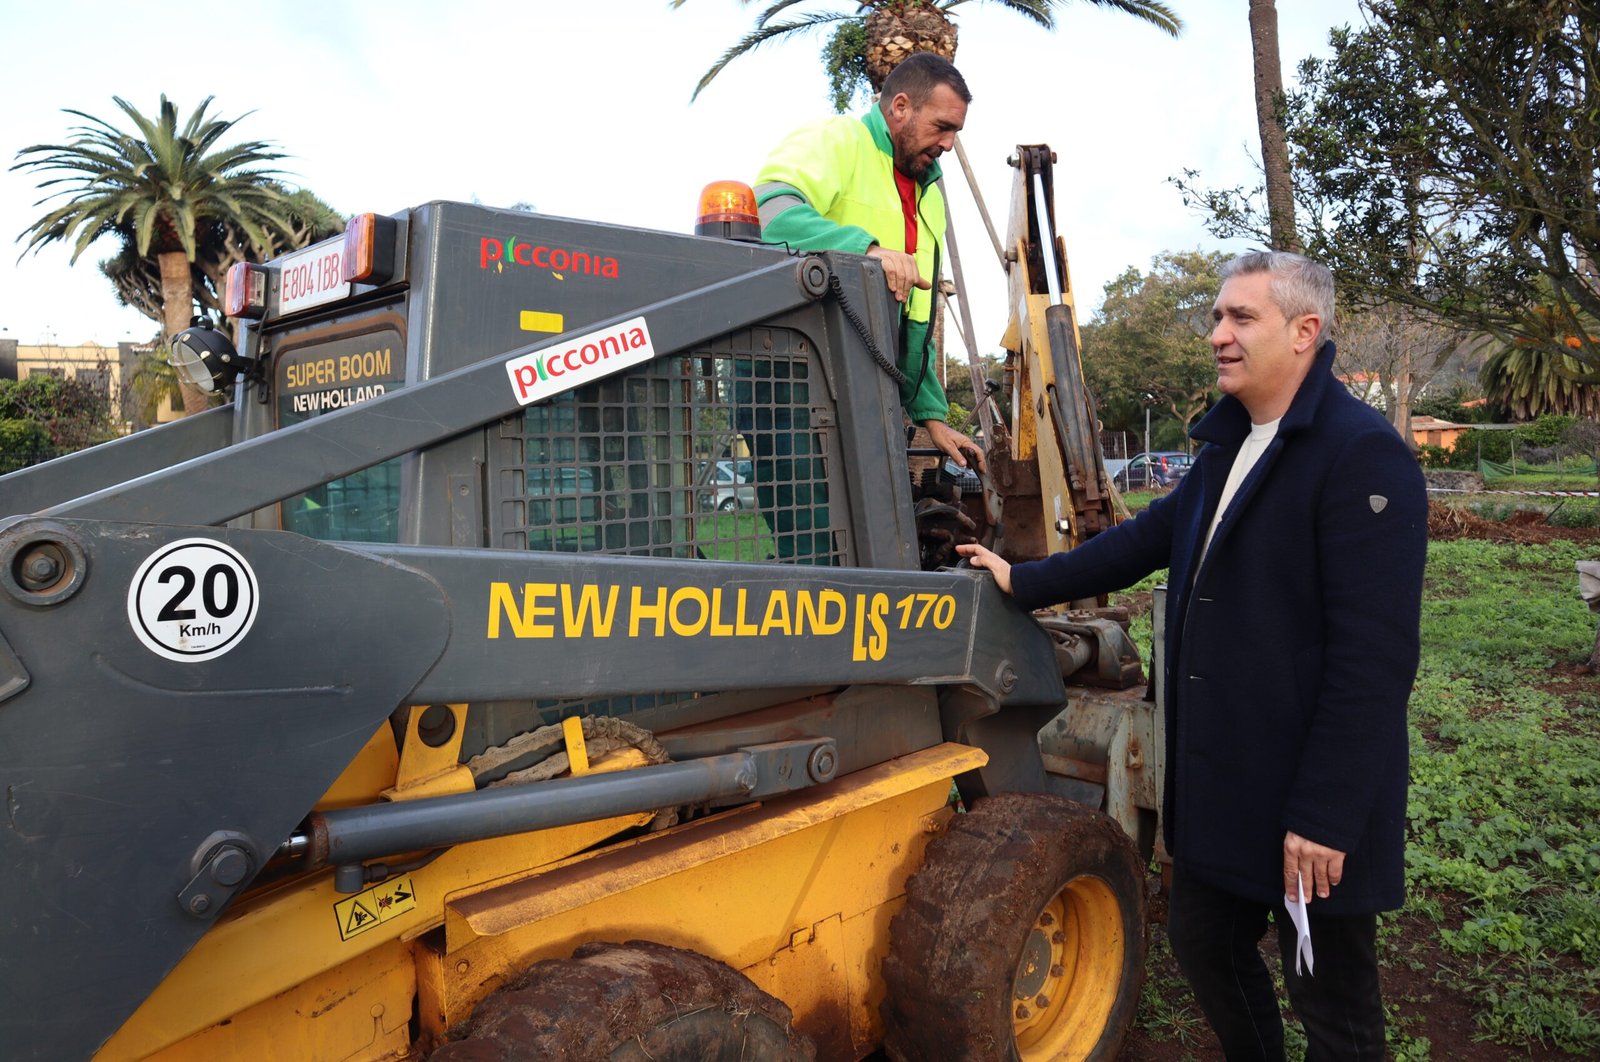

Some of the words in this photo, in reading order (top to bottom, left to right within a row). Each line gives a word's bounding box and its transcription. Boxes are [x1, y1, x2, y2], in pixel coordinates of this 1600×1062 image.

[479, 235, 620, 279] picconia
[286, 358, 336, 388] SUPER
[339, 348, 391, 382] BOOM
[513, 327, 647, 399] picconia
[293, 392, 320, 413] NEW
[321, 384, 385, 409] HOLLAND
[156, 563, 239, 622] 20
[179, 622, 222, 638] Km/h
[487, 582, 620, 639] NEW
[628, 586, 847, 637] HOLLAND
[852, 592, 890, 662] LS
[895, 593, 956, 630] 170
